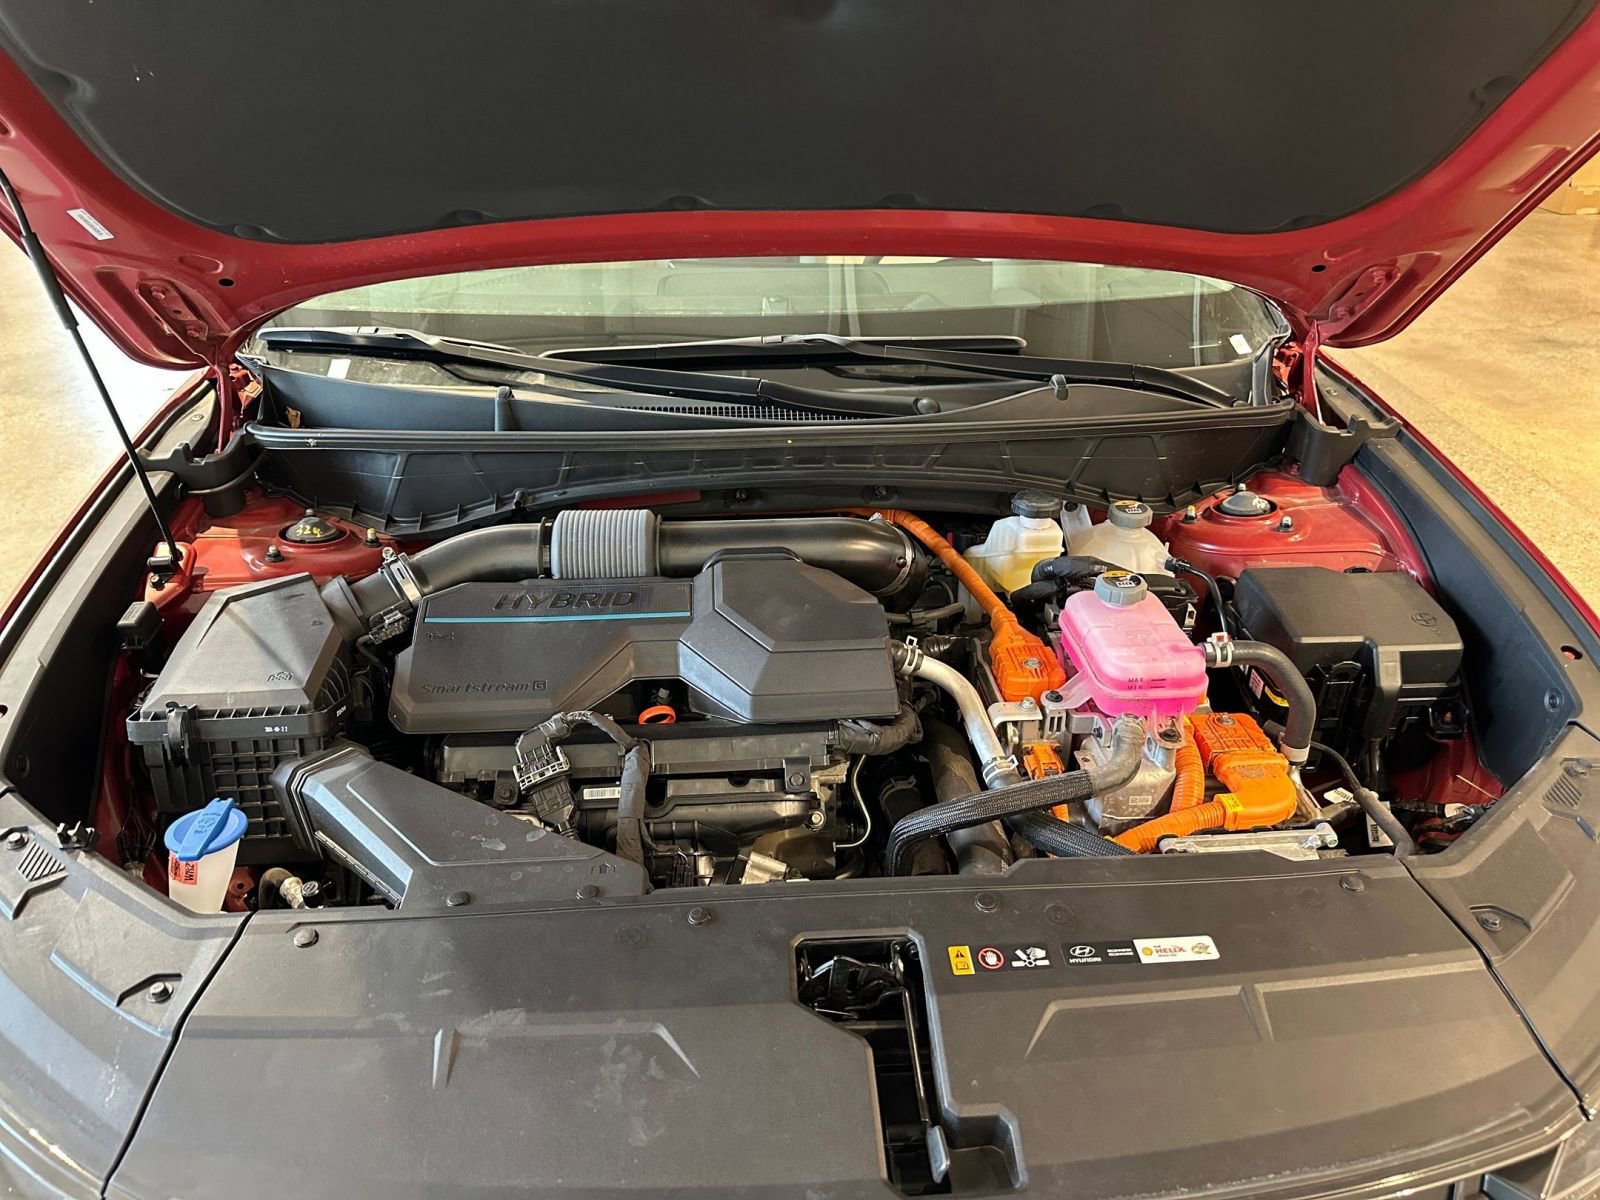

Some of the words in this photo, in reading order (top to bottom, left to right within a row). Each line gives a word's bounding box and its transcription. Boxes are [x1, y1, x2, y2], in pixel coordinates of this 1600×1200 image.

[493, 592, 635, 610] HYBRID
[422, 682, 530, 695] Smartstream
[1155, 946, 1186, 954] HELIX
